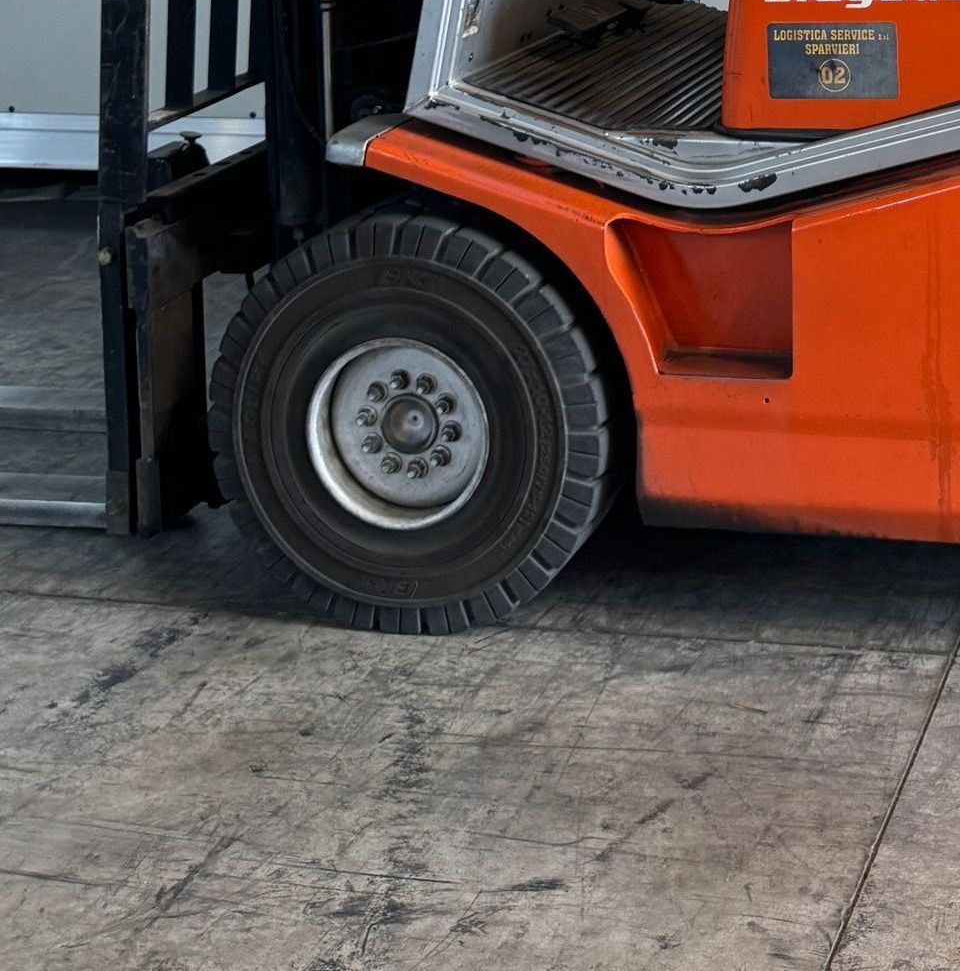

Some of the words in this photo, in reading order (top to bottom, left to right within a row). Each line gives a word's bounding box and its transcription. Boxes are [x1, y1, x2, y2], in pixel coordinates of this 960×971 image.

[773, 29, 828, 41] LOGISTICA
[831, 29, 875, 41] SERVICE
[805, 43, 860, 55] SPARVIERI
[820, 67, 846, 84] 02
